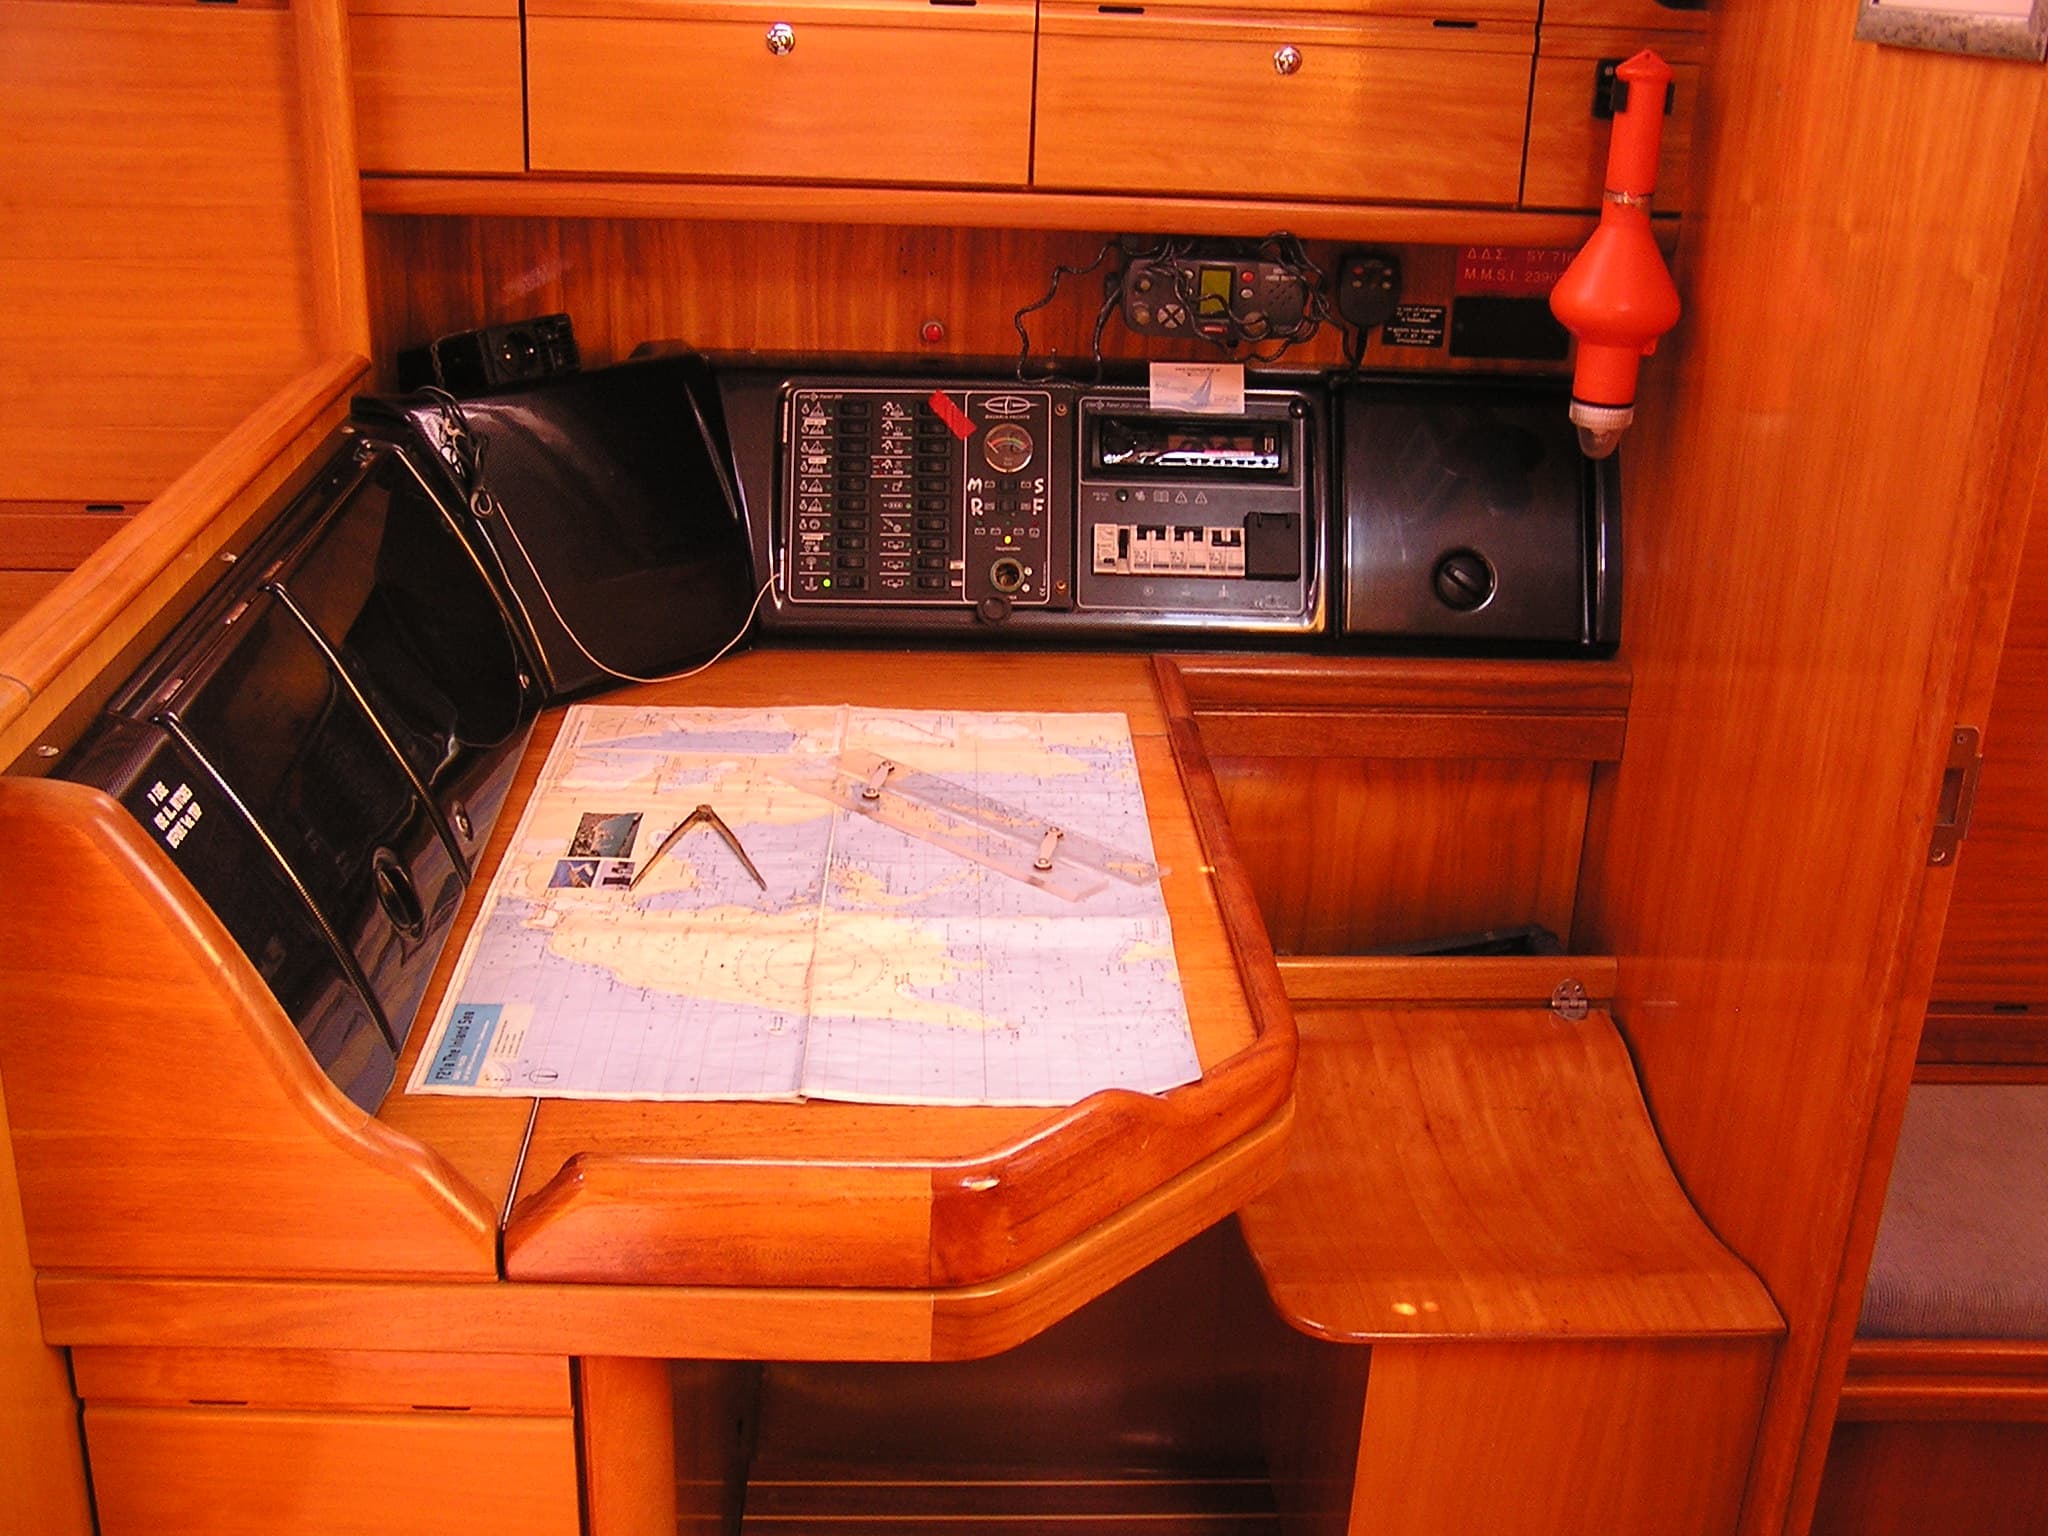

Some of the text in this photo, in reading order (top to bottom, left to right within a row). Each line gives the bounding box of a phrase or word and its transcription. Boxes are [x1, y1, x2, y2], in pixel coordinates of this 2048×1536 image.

[967, 478, 983, 494] M
[1034, 478, 1044, 494] S
[970, 497, 983, 516] R
[1032, 498, 1045, 516] F
[457, 1011, 475, 1024] Sea
